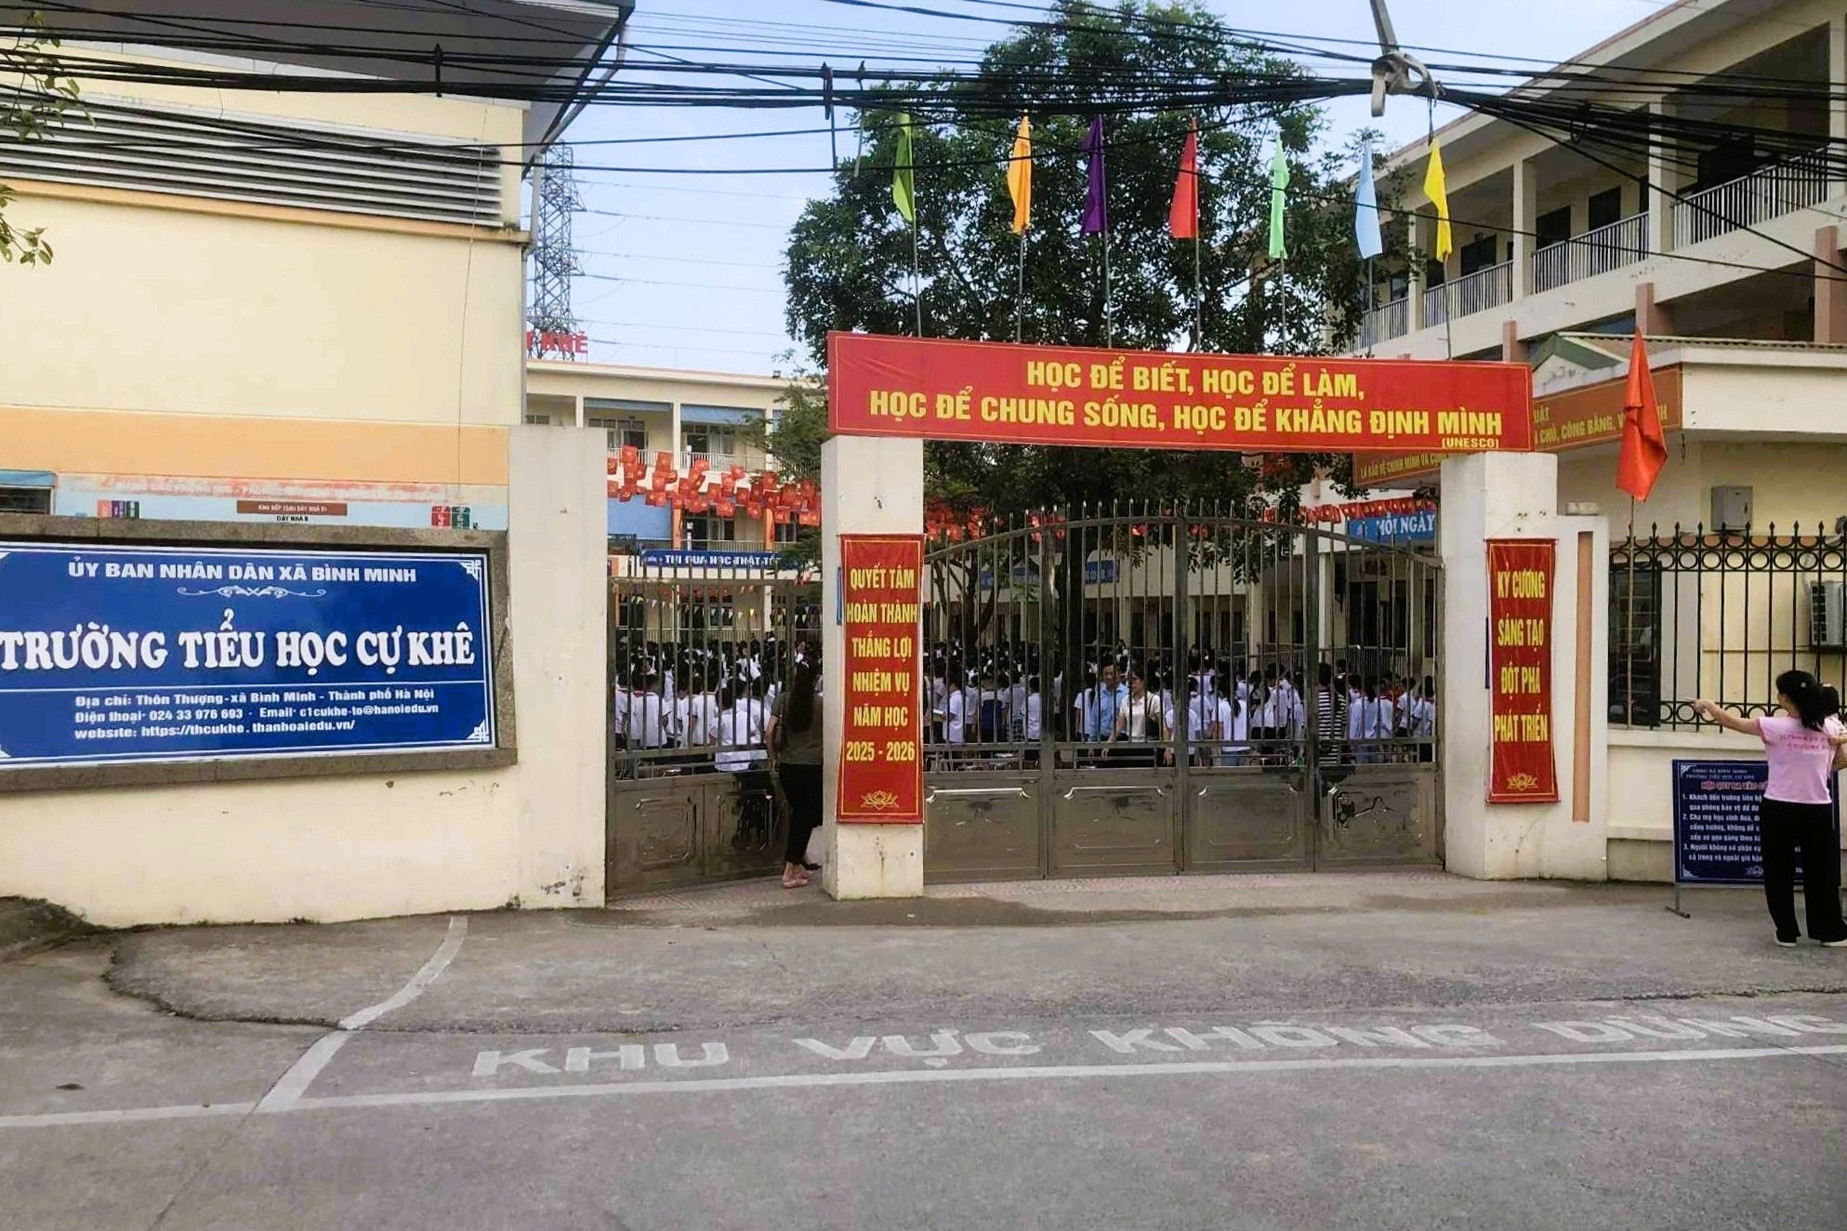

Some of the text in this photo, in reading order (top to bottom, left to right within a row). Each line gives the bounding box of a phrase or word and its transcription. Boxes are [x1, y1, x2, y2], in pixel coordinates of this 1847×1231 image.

[1027, 355, 1365, 400] HỌC ĐỂ BIẾT, HỌC ĐỂ LÀM,
[870, 385, 1503, 440] HỌC ĐỂ CHUNG SỐNG, HỌC ĐỂ KHẲNG ĐỊNH MÌNH
[1441, 437, 1500, 449] (UNESCO)
[1400, 511, 1435, 533] NGÀY
[68, 556, 417, 582] ỦY BAN NHÂN DÂN XÃ BÌNH MINH
[850, 562, 915, 590] QUYẾT TÂM
[1512, 568, 1546, 599] CƯƠNG
[846, 599, 919, 623] HOÀN THÀNH
[0, 608, 475, 676] TRƯỜNG TIỂU HỌC CỰ KHÊ
[852, 630, 912, 662] THẮNG LỢI
[1498, 612, 1545, 653] SÁNG TẠO
[853, 667, 910, 697] NHIỆM VỤ
[1501, 660, 1541, 701] ĐỘT PHÁ
[75, 696, 100, 709] Địa
[136, 694, 170, 706] Thôn
[250, 692, 280, 703] Bình
[283, 691, 316, 702] Minh
[369, 687, 392, 701] phố
[394, 688, 411, 700] Hà
[414, 688, 435, 701] Nội
[75, 711, 105, 724] Điện
[149, 709, 173, 721] 024
[176, 709, 192, 720] 33
[195, 708, 218, 719] 976
[220, 708, 243, 719] 693
[854, 703, 909, 731] NĂM HỌC
[1494, 703, 1548, 742] PHÁT TRIỂN
[846, 741, 875, 762] 2025
[886, 741, 916, 762] 2026
[471, 1041, 729, 1077] KHU
[792, 1028, 1040, 1067] VỰC
[1088, 1020, 1507, 1054] KHÔNG
